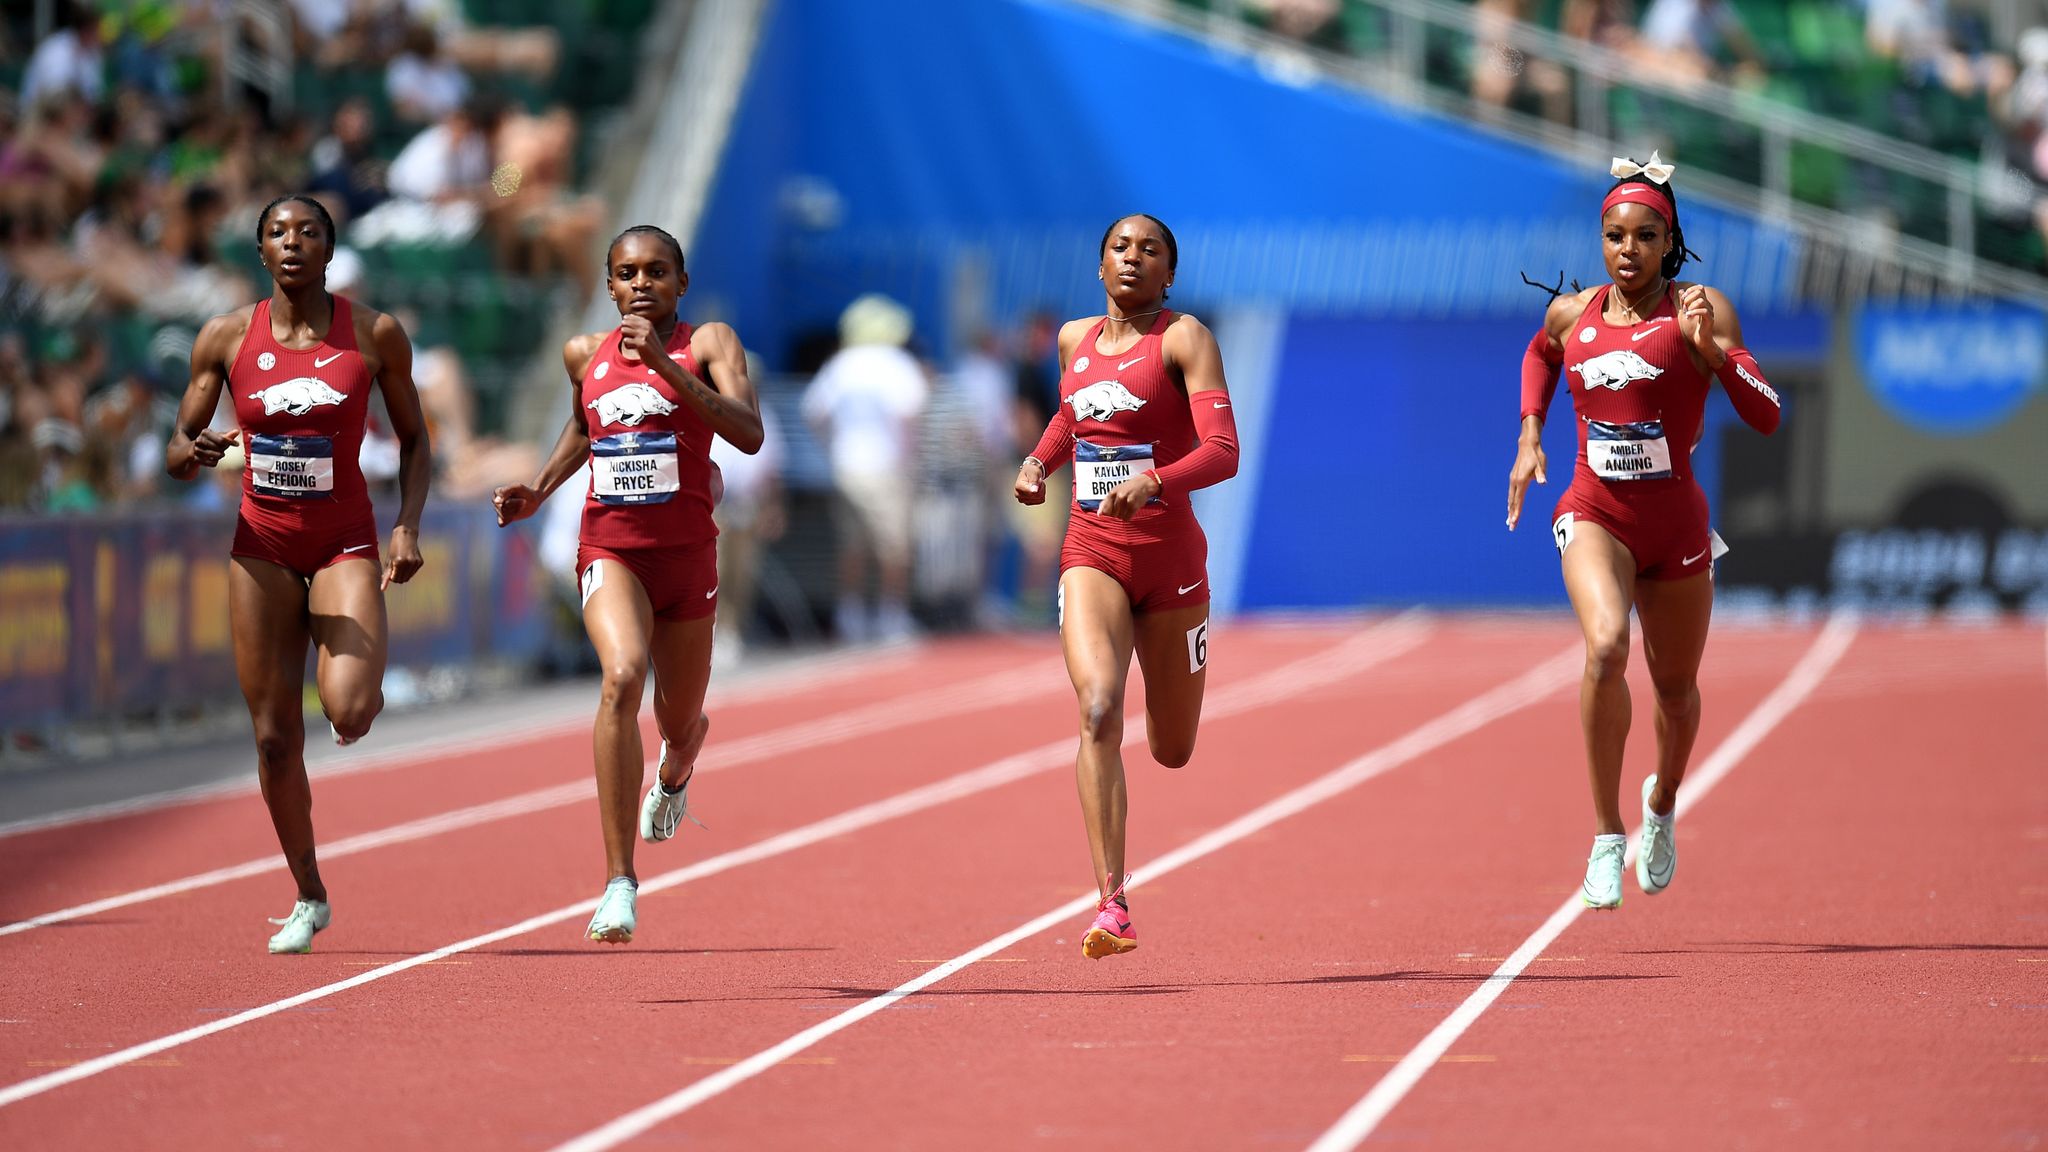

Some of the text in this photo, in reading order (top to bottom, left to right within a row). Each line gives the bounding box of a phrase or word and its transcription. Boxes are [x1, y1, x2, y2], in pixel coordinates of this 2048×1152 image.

[1610, 443, 1644, 455] AMBER
[275, 460, 307, 472] ROSEY
[609, 459, 658, 473] NICKISHA
[1094, 464, 1130, 478] KAYLYN
[1605, 456, 1653, 471] ANNING
[268, 472, 317, 488] EFFIONG
[614, 475, 655, 490] PRYCE
[1556, 517, 1566, 551] 5
[1195, 624, 1207, 667] 6
